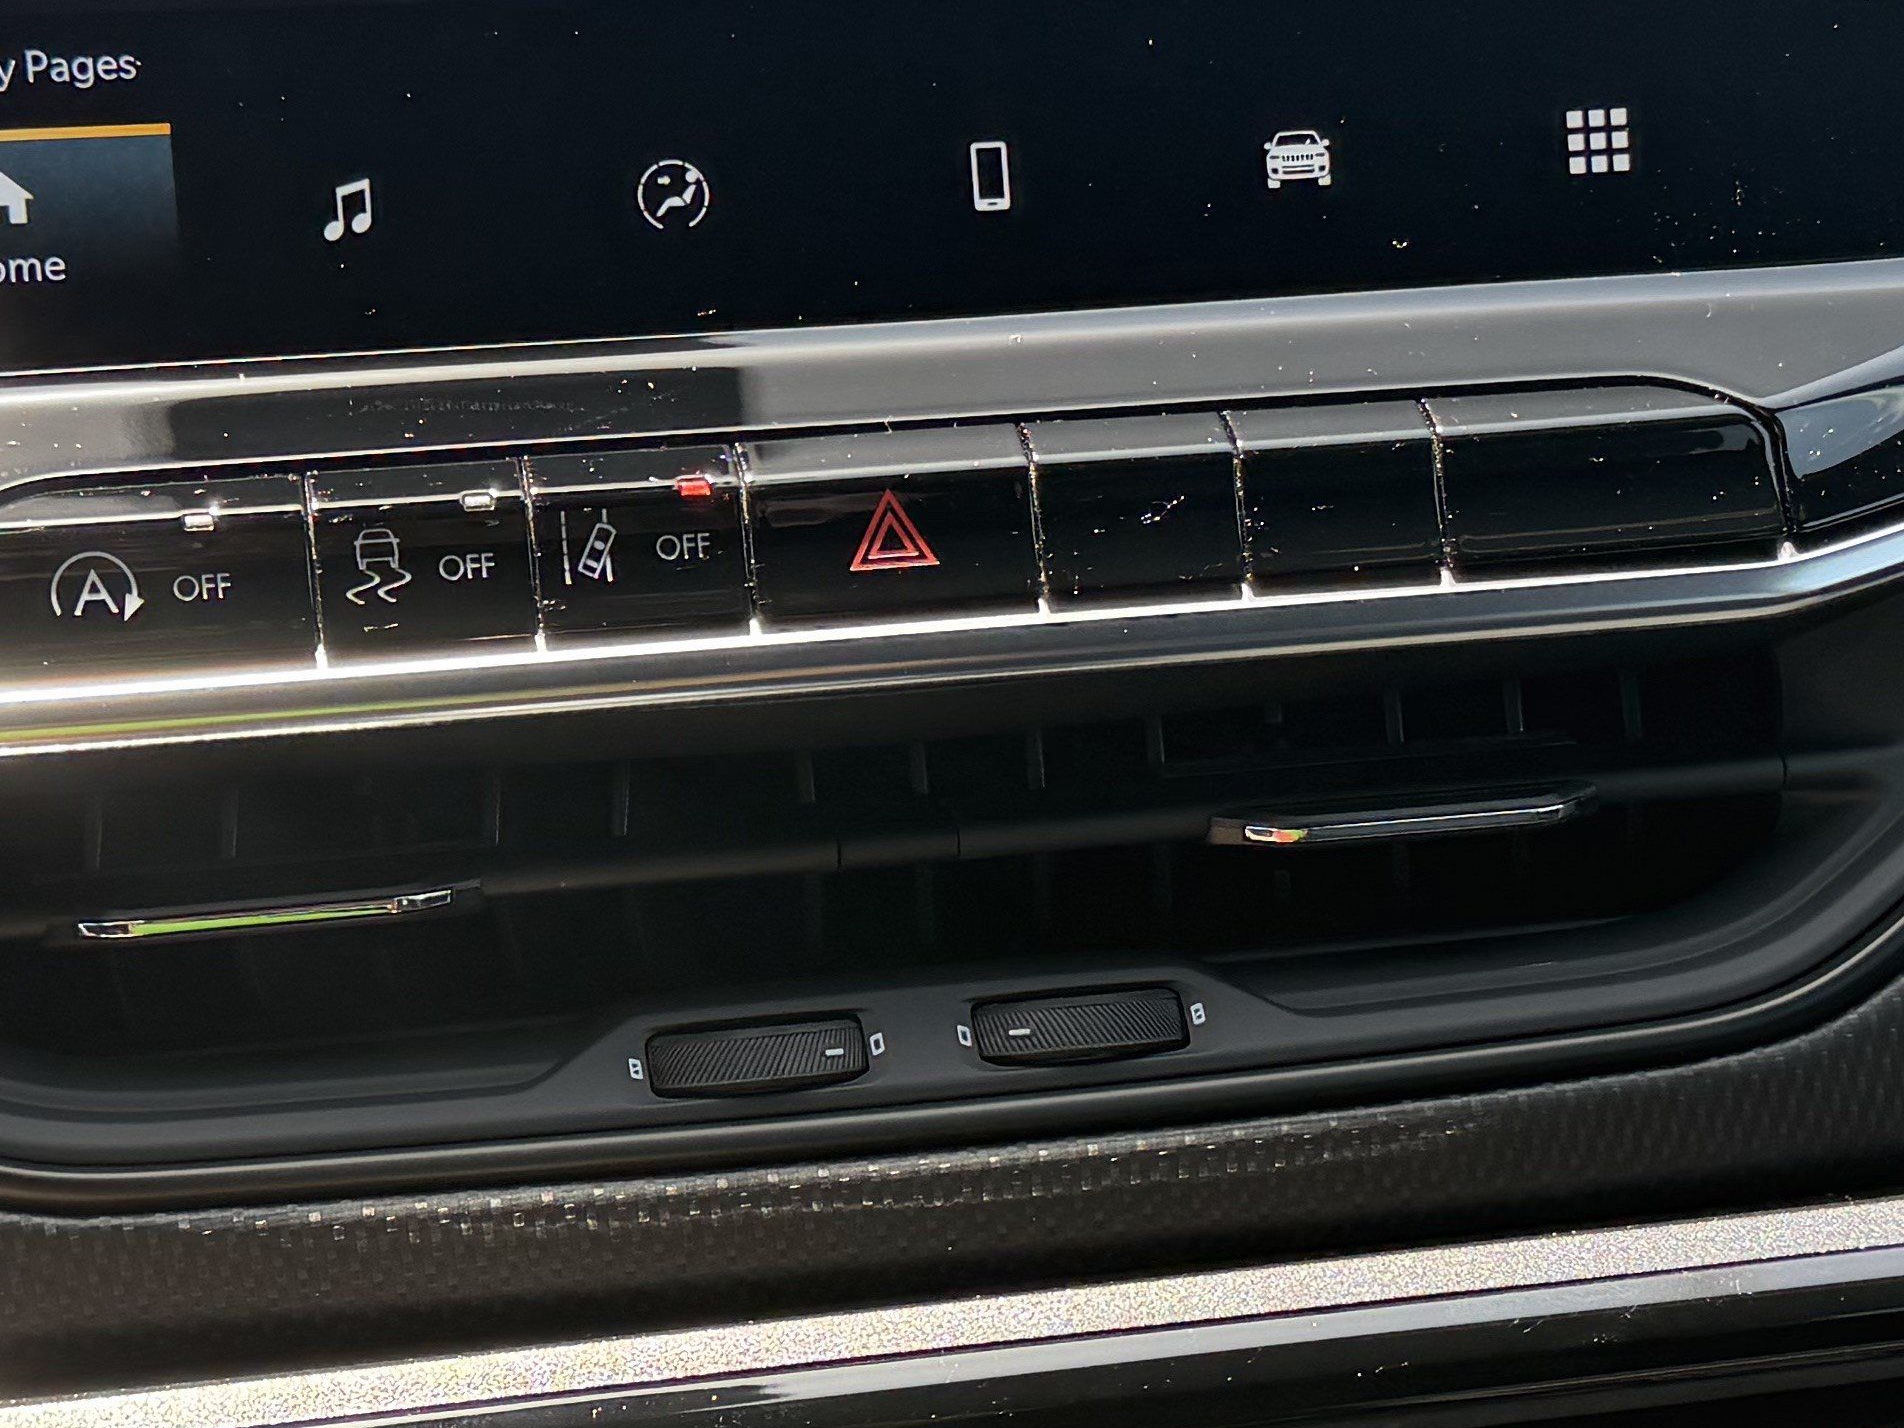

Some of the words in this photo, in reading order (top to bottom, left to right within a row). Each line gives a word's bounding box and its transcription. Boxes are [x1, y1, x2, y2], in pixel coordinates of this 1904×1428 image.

[24, 46, 131, 92] Pages
[655, 531, 712, 562] OFF
[438, 551, 496, 582] OFF
[173, 572, 232, 603] OFF
